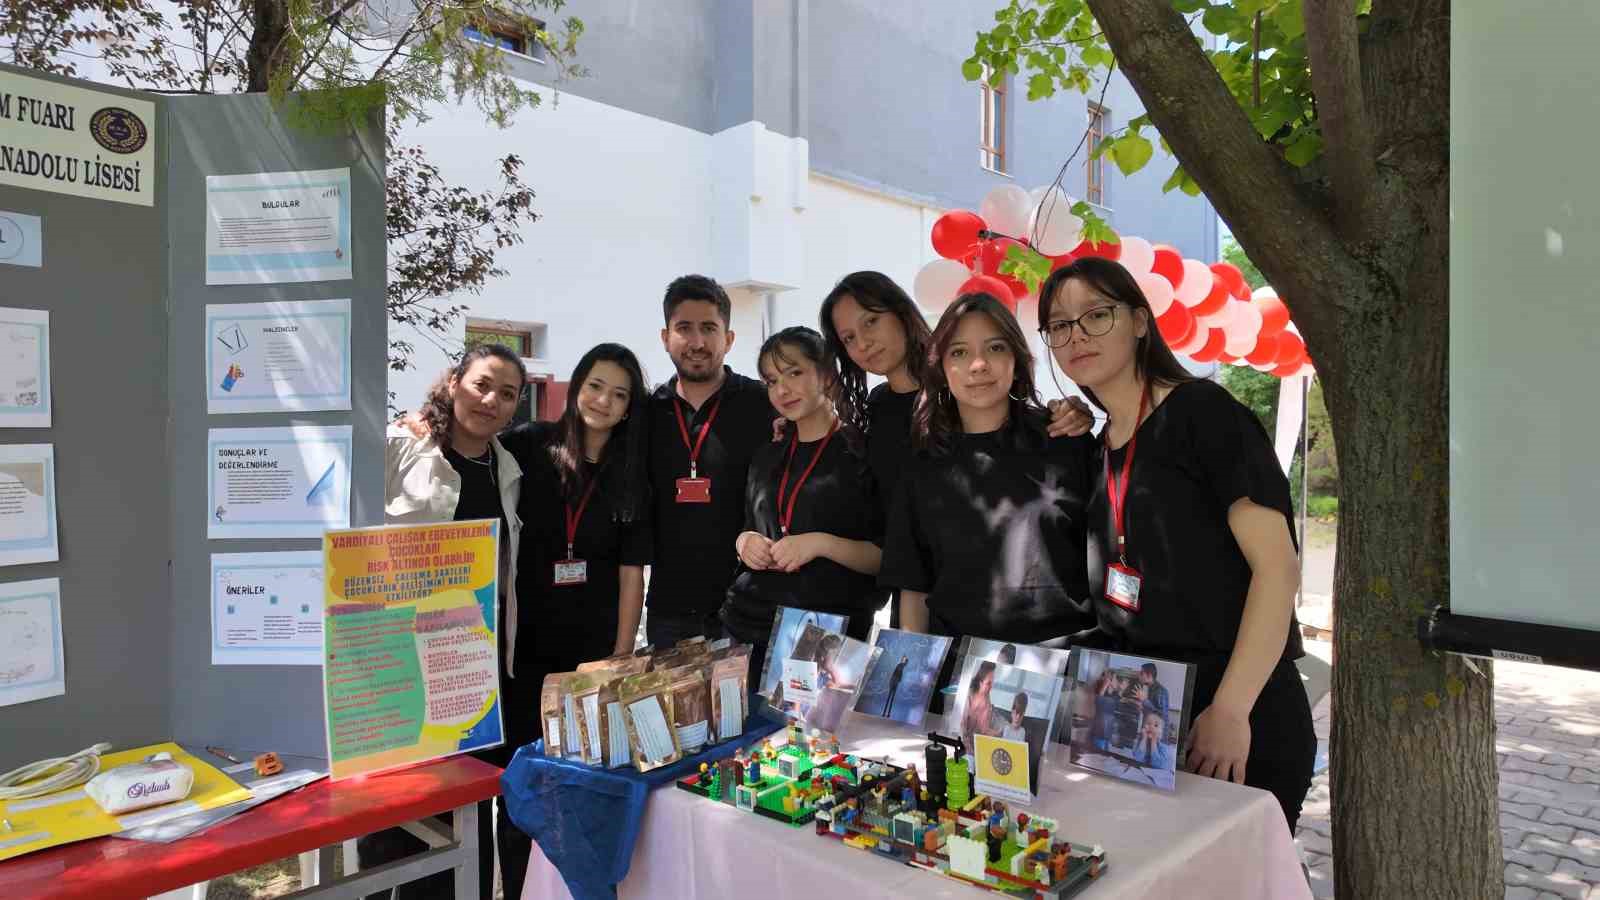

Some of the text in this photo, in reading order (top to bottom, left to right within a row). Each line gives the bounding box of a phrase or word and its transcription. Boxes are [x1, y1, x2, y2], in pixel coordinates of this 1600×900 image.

[17, 96, 75, 131] FUARI
[0, 145, 141, 192] NADOLU LİSESİ
[261, 200, 300, 209] BULGULAR
[218, 448, 268, 459] SONUÇLAR VE
[226, 585, 265, 596] ÖNERİLER
